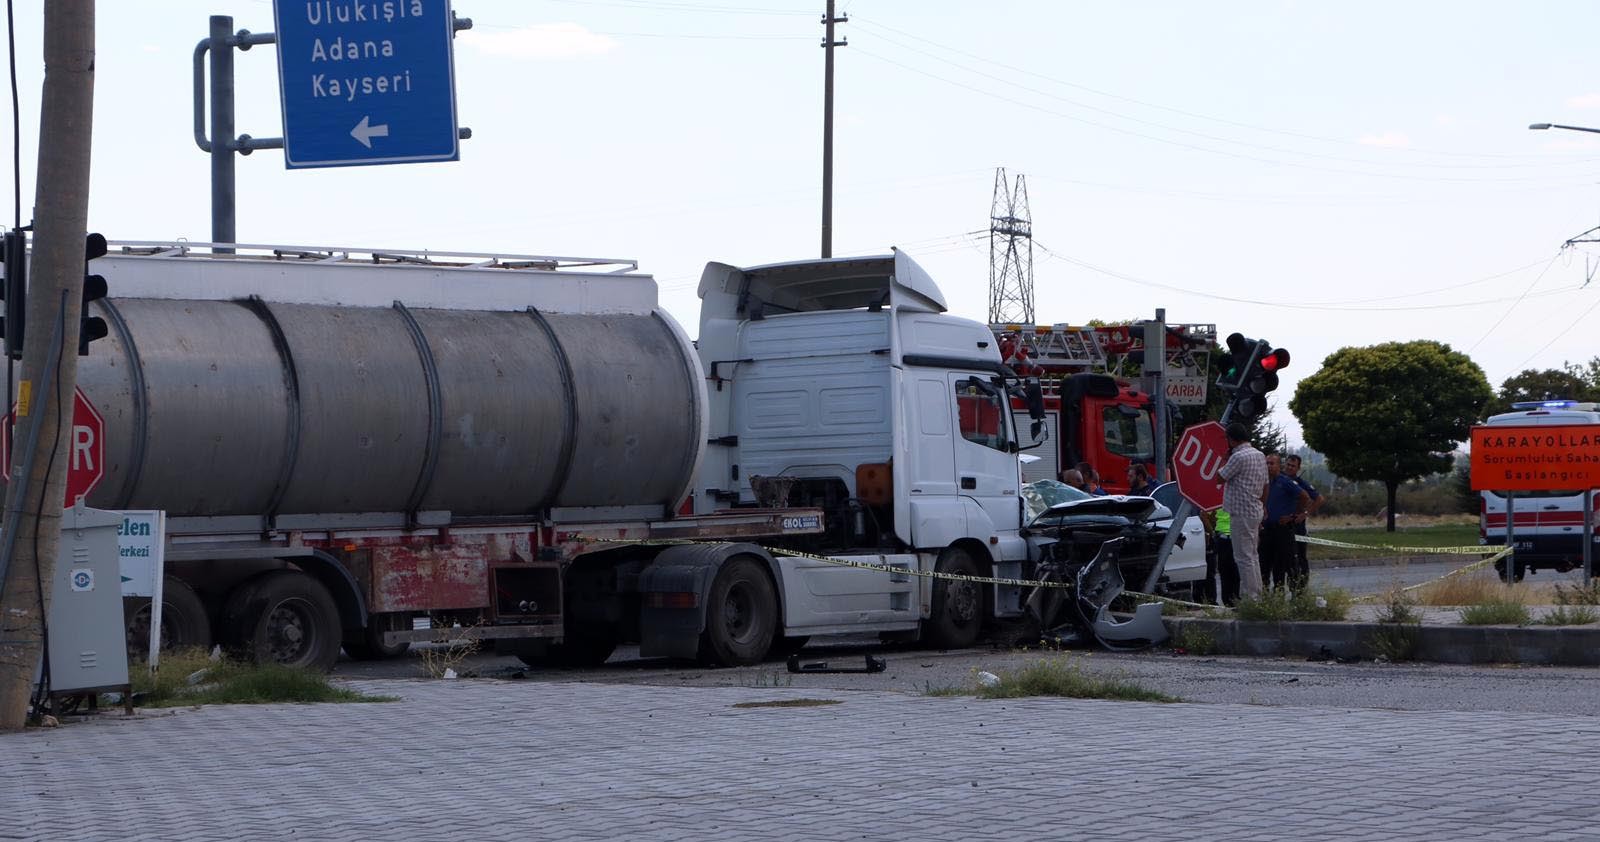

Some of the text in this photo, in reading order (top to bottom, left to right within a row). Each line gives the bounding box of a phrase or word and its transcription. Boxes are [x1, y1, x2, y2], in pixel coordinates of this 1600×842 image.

[307, 0, 423, 25] Ulukışla
[312, 38, 394, 62] Adana
[312, 70, 411, 101] Kayseri
[784, 518, 802, 529] EKOL
